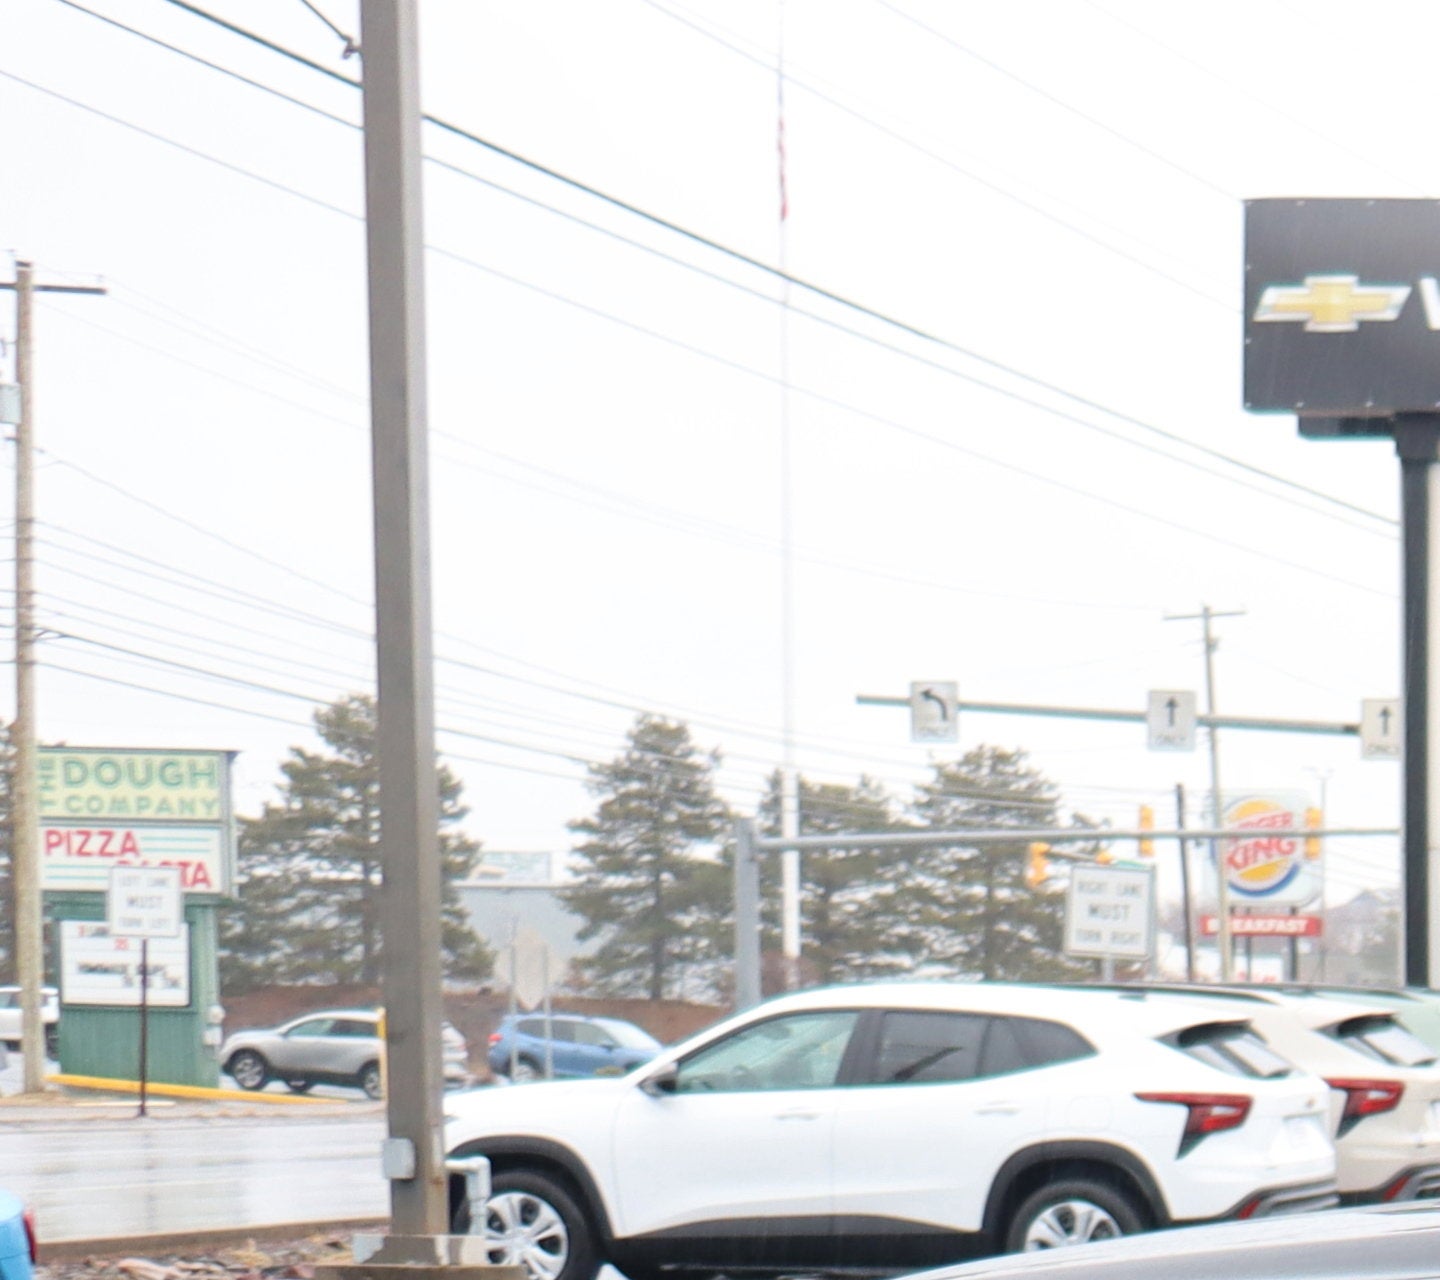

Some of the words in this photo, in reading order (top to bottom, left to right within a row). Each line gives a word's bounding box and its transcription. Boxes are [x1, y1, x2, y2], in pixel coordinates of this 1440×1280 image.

[64, 757, 217, 790] DOUGH
[65, 794, 219, 816] COMPANY
[44, 828, 140, 858] PIZZA
[1088, 903, 1131, 920] MUST
[1206, 918, 1308, 934] BEAKFAST
